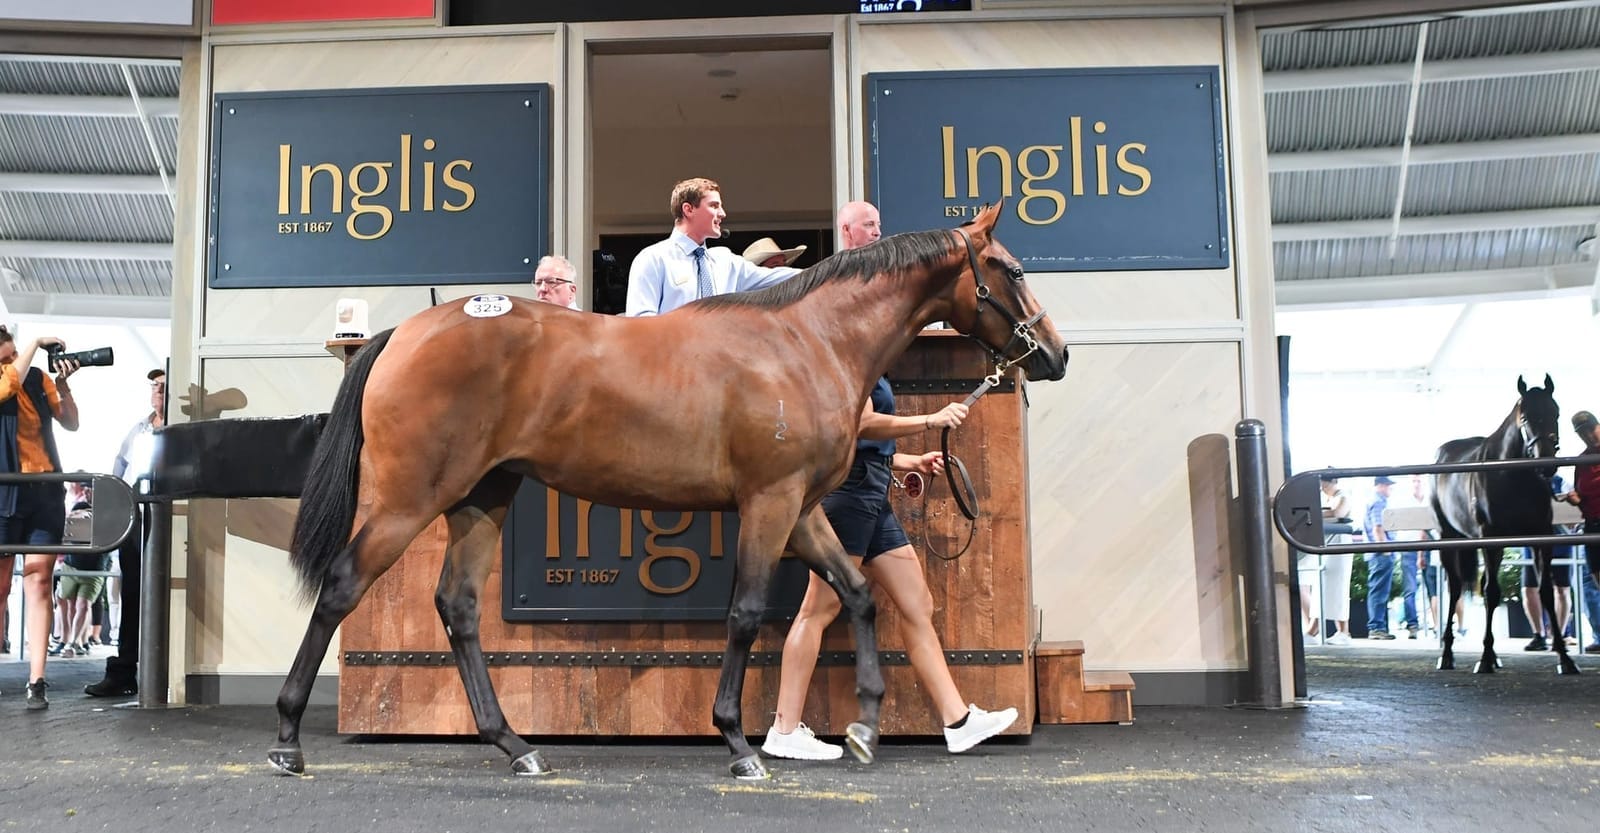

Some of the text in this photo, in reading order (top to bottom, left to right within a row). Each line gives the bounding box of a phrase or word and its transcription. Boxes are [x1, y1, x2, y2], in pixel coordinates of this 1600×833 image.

[873, 3, 895, 12] 1867
[942, 116, 1152, 225] Inglis
[278, 134, 476, 240] Inglis
[944, 205, 968, 217] EST
[278, 221, 334, 234] EST 1867
[473, 303, 503, 314] 325
[545, 567, 620, 584] EST 1867
